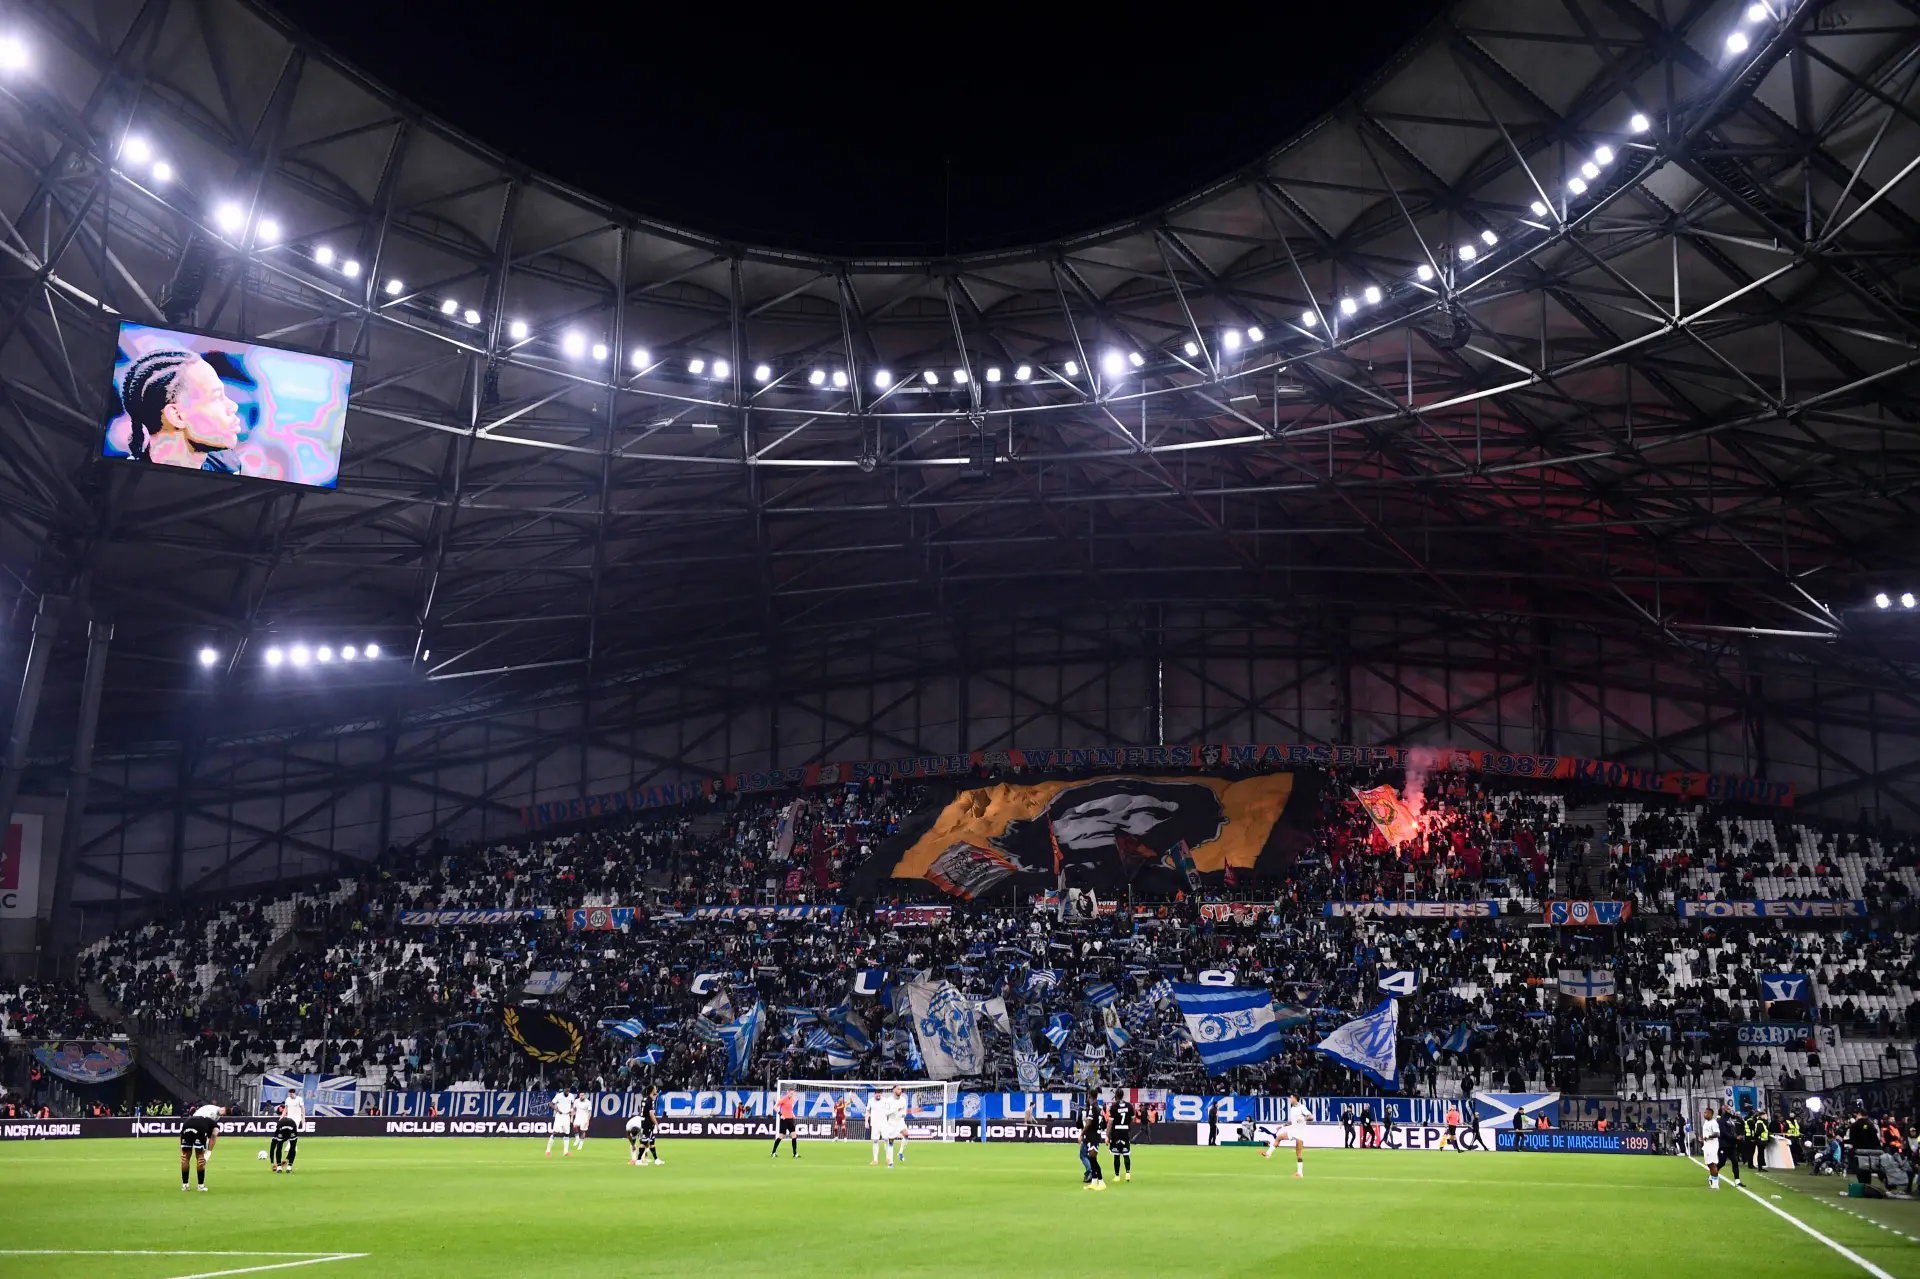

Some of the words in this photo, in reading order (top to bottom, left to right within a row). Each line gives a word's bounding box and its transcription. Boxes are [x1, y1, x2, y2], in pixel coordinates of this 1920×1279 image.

[735, 767, 807, 792] 1987
[851, 753, 970, 781] SOUTH
[1022, 746, 1192, 767] WINNERS
[1227, 744, 1438, 769] MARSEILL
[1480, 752, 1557, 777] 1987
[1573, 758, 1662, 791] KAOTIC
[1705, 775, 1788, 805] GROUP
[1331, 902, 1492, 917] WINNERS
[1683, 901, 1759, 917] FOR
[1763, 901, 1860, 917] EVER
[298, 1089, 346, 1105] ARSEILLE
[1172, 1094, 1239, 1122] 84
[1120, 1112, 1126, 1125] 7
[4, 1123, 81, 1137] NOSTALGIQUE
[131, 1122, 184, 1134] INCLU
[386, 1121, 445, 1133] INCLUS
[451, 1121, 559, 1133] NOSTALGIQU
[1498, 1133, 1550, 1149] OLYPIQUE
[1552, 1134, 1565, 1148] DE
[1567, 1135, 1620, 1150] MARSEILLE
[1625, 1136, 1649, 1150] 1899
